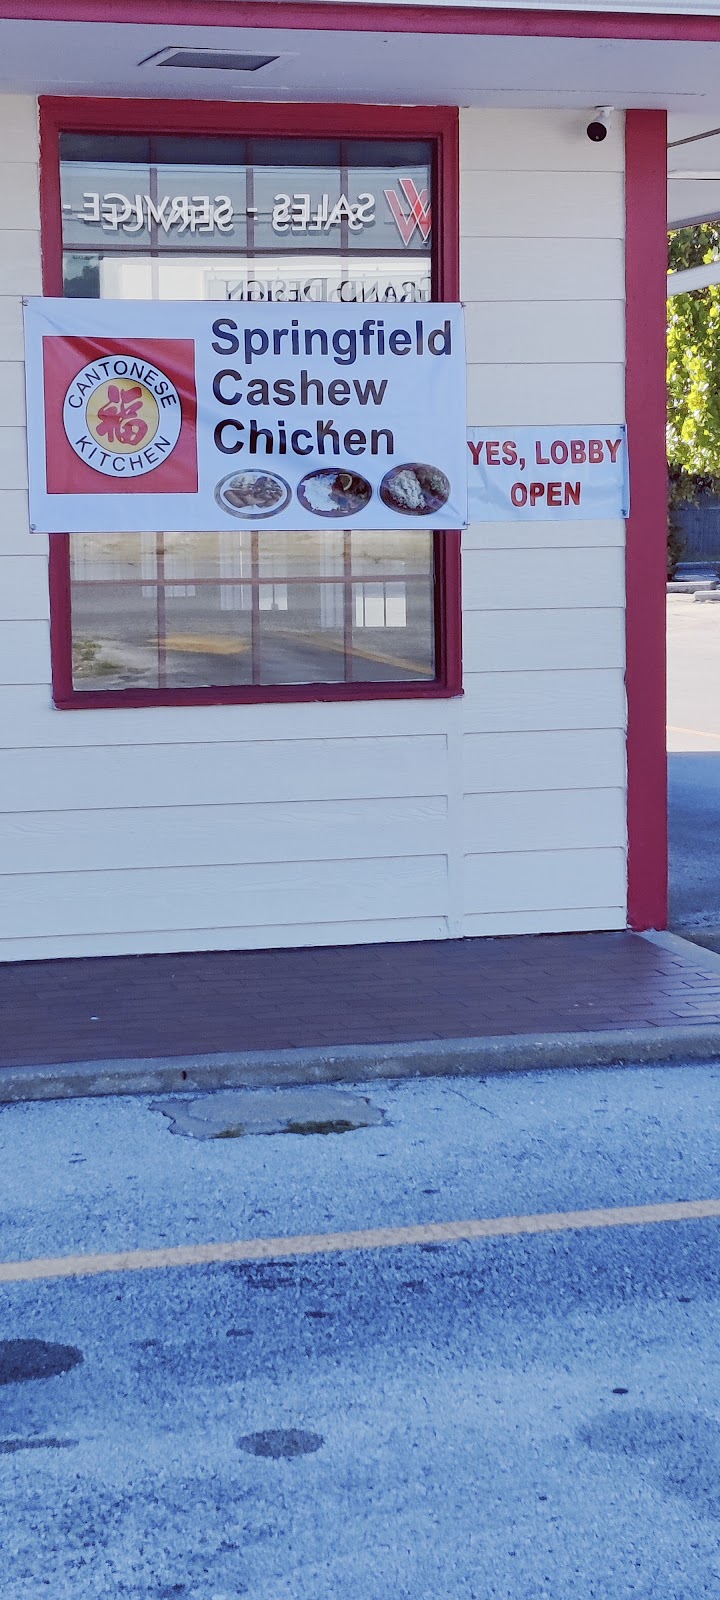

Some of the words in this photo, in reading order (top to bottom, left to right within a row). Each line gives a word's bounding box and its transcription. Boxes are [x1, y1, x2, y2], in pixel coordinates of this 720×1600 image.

[211, 318, 452, 365] Springfield
[68, 360, 177, 409] CANTONESE
[212, 369, 388, 406] Cashew
[75, 435, 171, 472] KITCHEN
[213, 419, 394, 455] Chicken
[466, 440, 526, 471] YES,
[535, 439, 622, 465] LOBBY
[510, 481, 581, 507] OPEN
